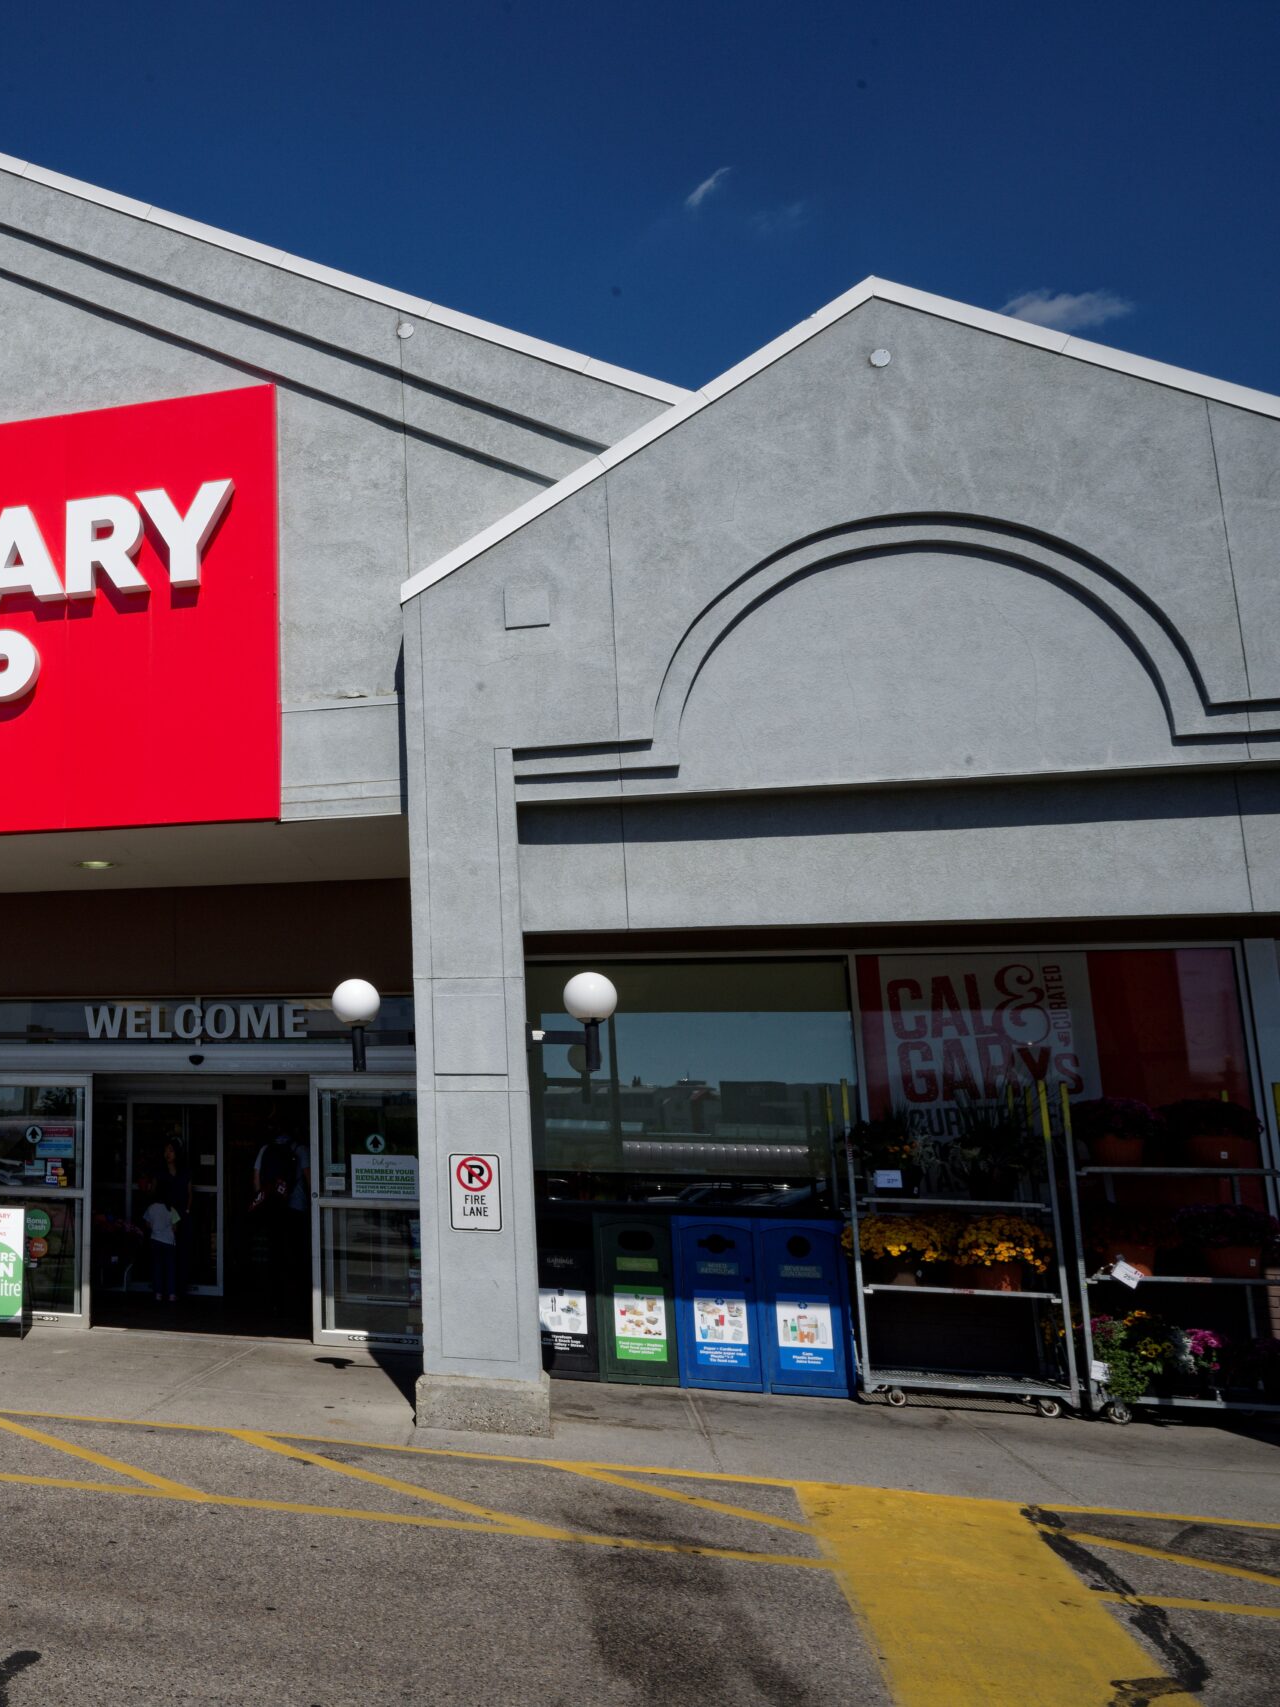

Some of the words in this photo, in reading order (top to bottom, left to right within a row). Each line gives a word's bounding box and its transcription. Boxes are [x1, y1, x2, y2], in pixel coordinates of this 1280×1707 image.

[84, 1003, 309, 1039] WELCOME
[464, 1195, 486, 1205] FIRE
[463, 1206, 489, 1217] LANE
